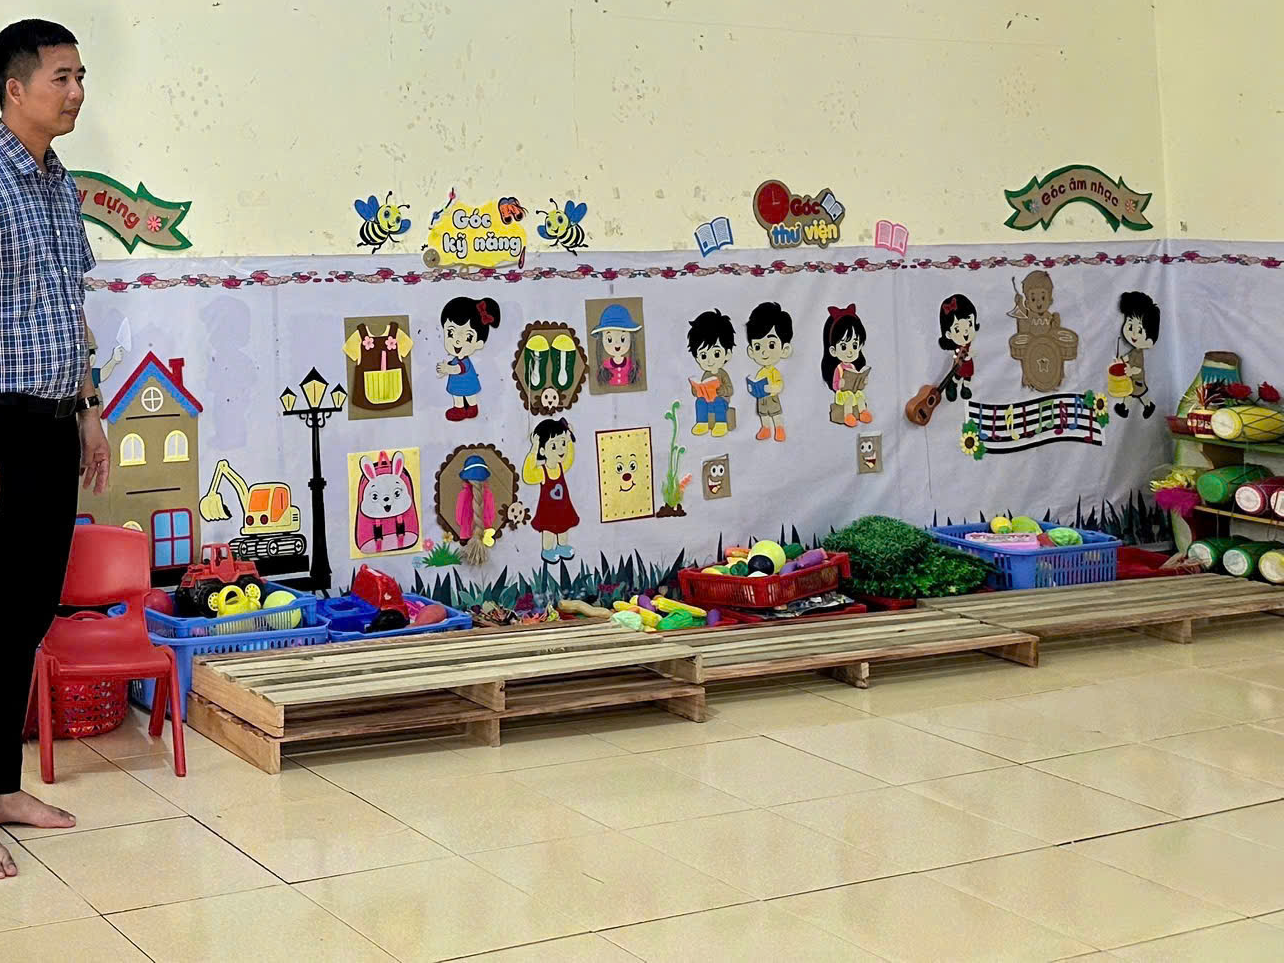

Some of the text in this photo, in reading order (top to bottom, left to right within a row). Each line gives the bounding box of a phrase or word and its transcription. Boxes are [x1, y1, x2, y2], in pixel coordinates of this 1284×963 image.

[77, 189, 88, 206] y
[1069, 177, 1087, 191] âm
[1090, 182, 1119, 207] nhạc
[790, 198, 821, 216] Góc
[452, 208, 492, 230] Góc
[771, 220, 838, 245] thư viện
[442, 231, 522, 259] kỹ năng
